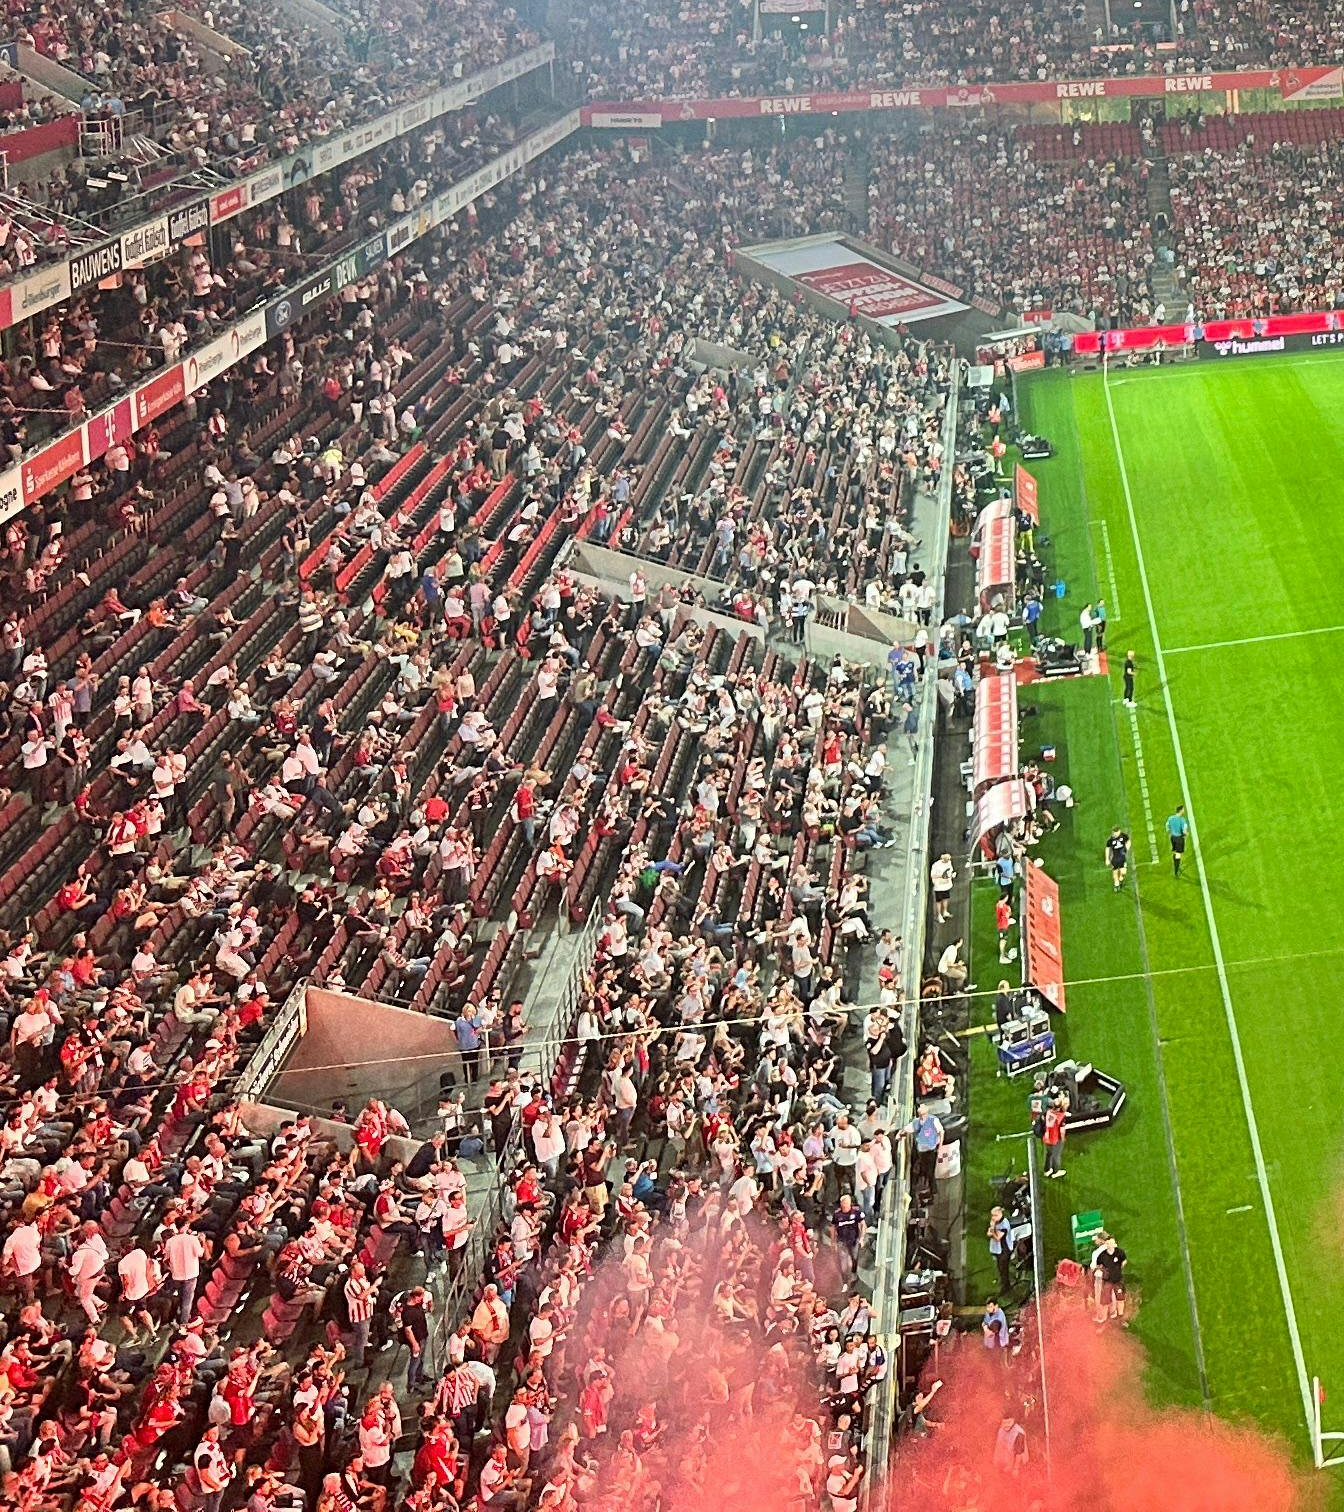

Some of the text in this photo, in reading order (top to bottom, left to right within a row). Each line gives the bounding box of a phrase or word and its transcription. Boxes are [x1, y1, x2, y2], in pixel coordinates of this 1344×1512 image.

[1056, 82, 1105, 98] REWE
[1165, 76, 1212, 91] REWE
[760, 97, 812, 114] REWE
[870, 91, 921, 108] REWE
[72, 245, 121, 289] BAUWENS
[336, 260, 357, 288] DEVK
[1232, 337, 1285, 355] hummel
[1311, 334, 1336, 346] LET'S
